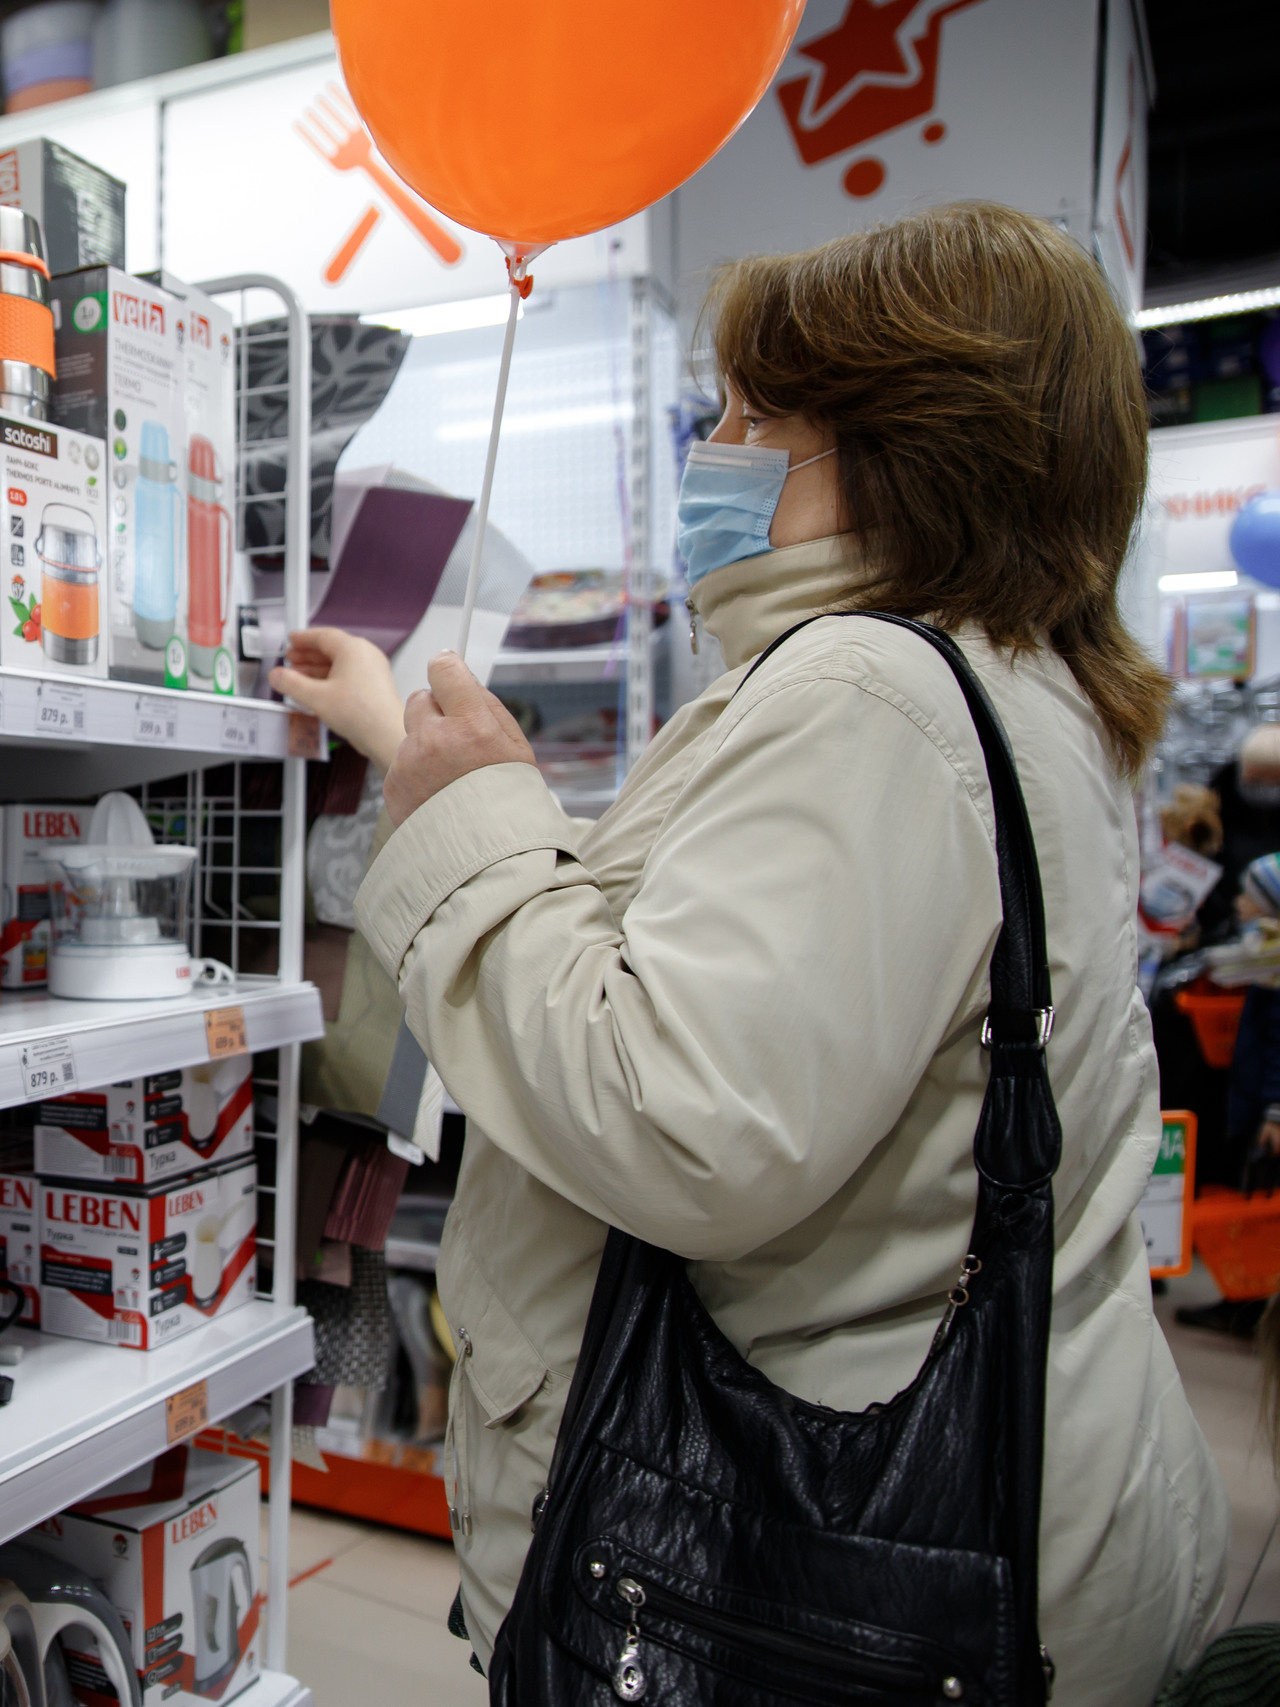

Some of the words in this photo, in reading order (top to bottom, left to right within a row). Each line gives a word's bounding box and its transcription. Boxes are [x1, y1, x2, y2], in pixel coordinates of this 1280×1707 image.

[4, 426, 51, 454] satoshi
[41, 707, 58, 722] 879
[23, 811, 81, 839] LEBEN
[31, 1071, 47, 1087] 879
[149, 1151, 176, 1171] Турка
[45, 1191, 140, 1232] LEBEN
[168, 1189, 204, 1217] LEBEN
[46, 1228, 74, 1242] Турка
[154, 1313, 181, 1337] Турка
[171, 1498, 217, 1544] LEBEN
